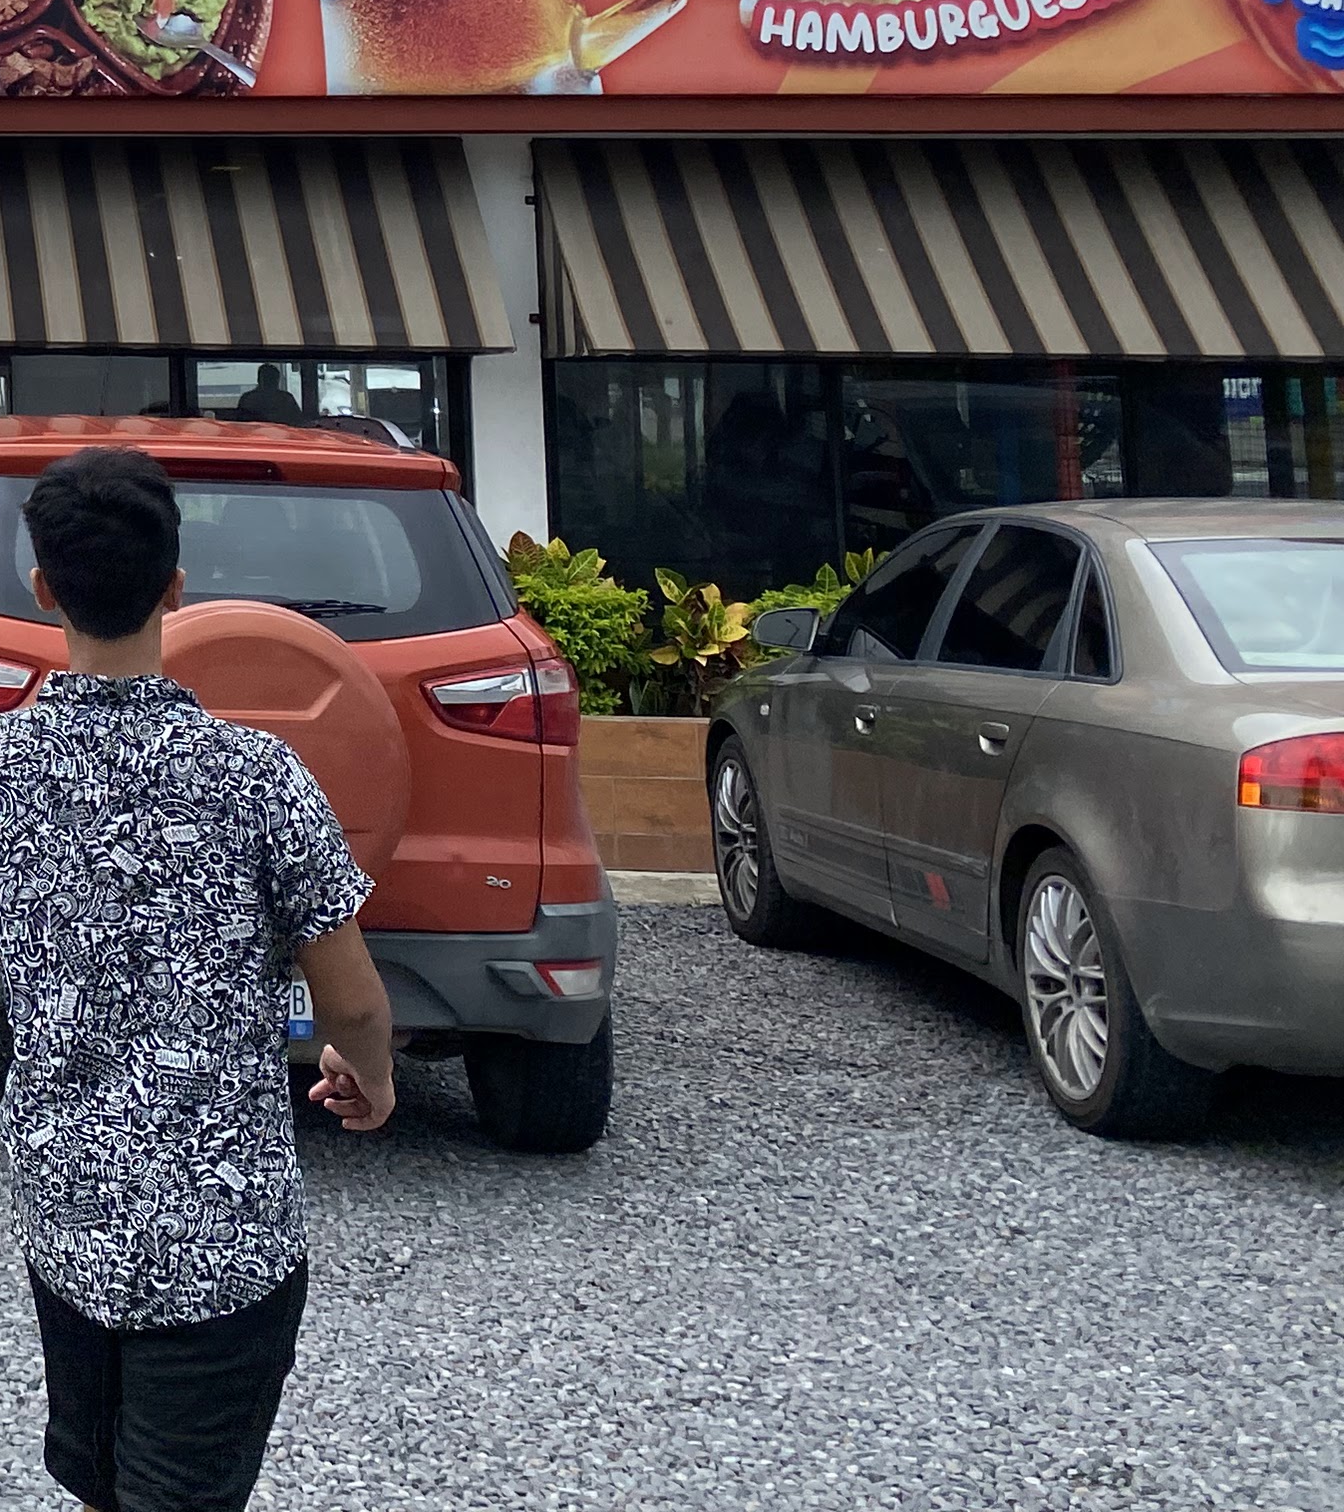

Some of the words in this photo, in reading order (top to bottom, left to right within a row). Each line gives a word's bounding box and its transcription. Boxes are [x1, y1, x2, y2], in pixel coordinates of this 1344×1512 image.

[3, 808, 43, 841] NATIVE
[163, 826, 198, 843] NATIVE
[80, 1161, 127, 1181] NATIVE
